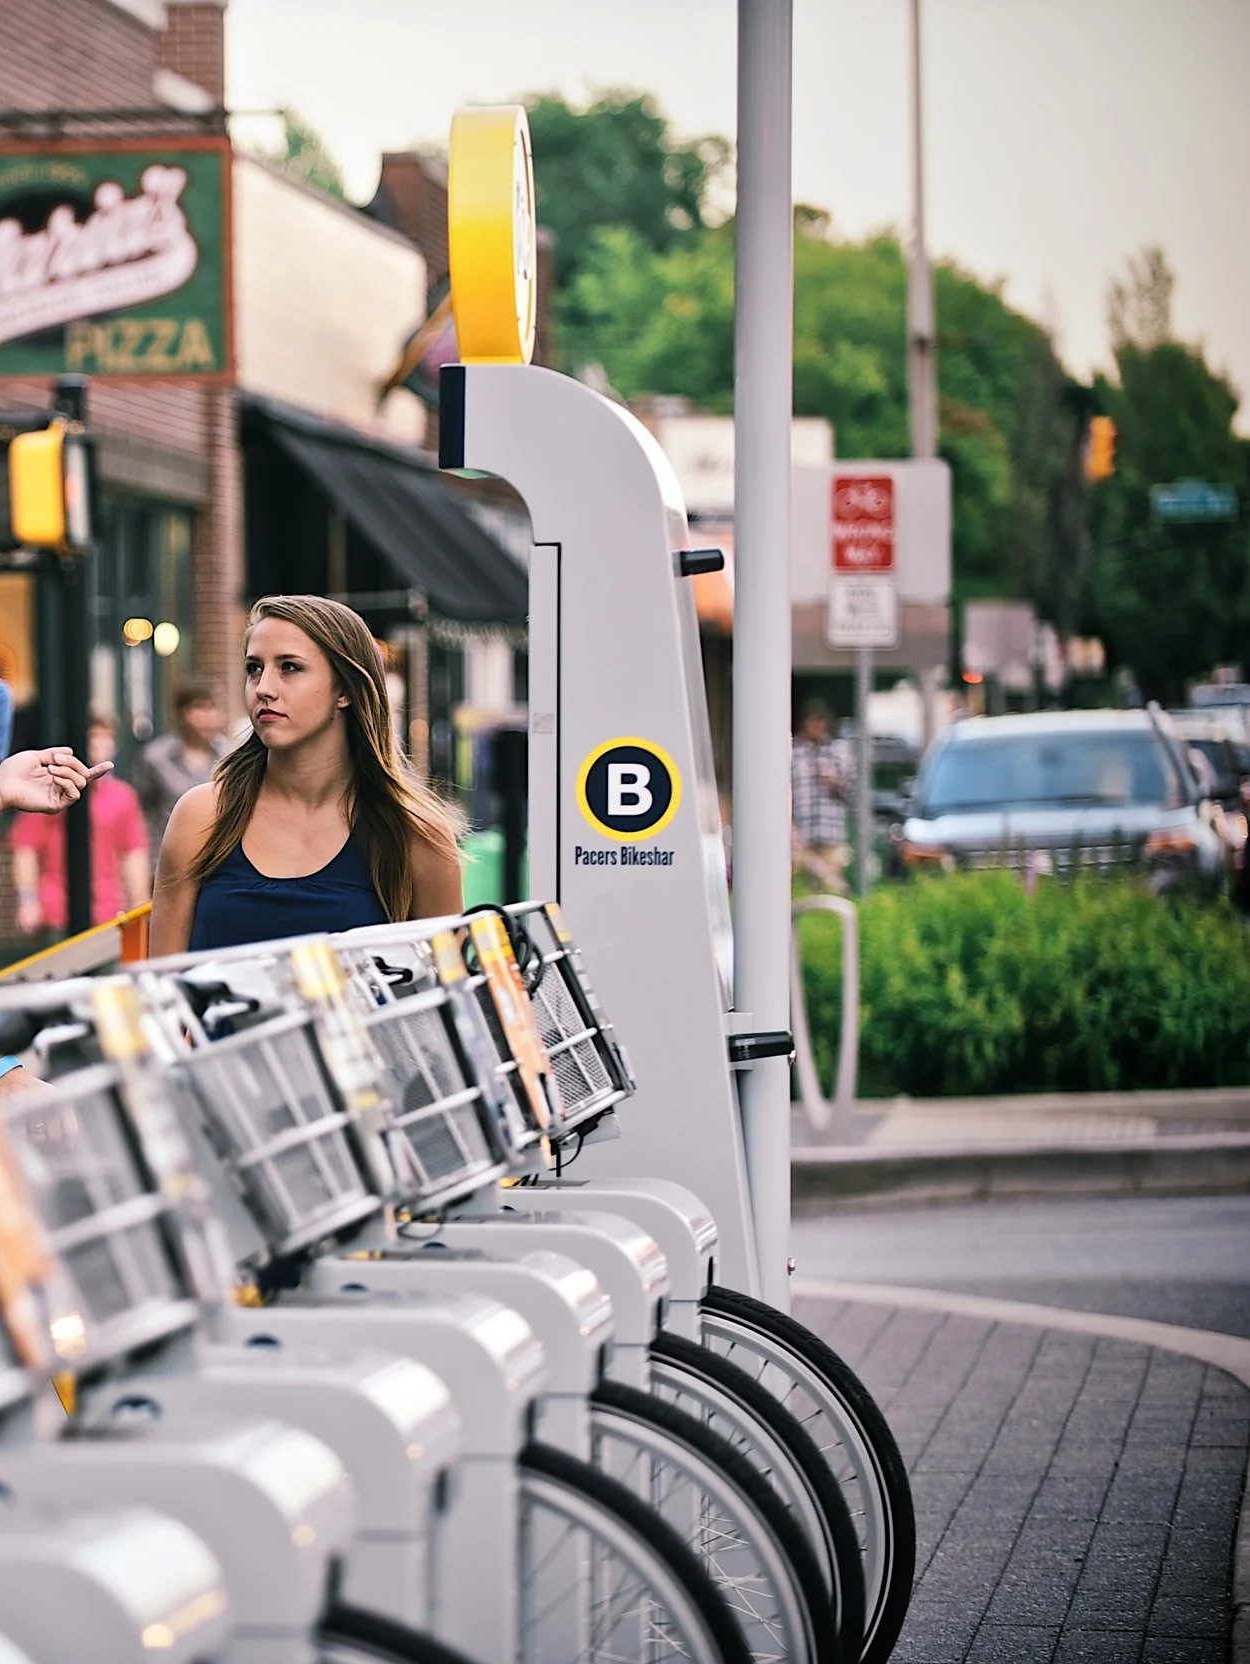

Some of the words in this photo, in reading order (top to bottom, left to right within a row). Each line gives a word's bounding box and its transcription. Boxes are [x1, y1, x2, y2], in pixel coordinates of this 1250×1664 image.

[65, 319, 214, 370] PIZZA
[607, 763, 653, 816] B
[575, 846, 617, 866] Pacers
[620, 846, 675, 866] Bikeshar
